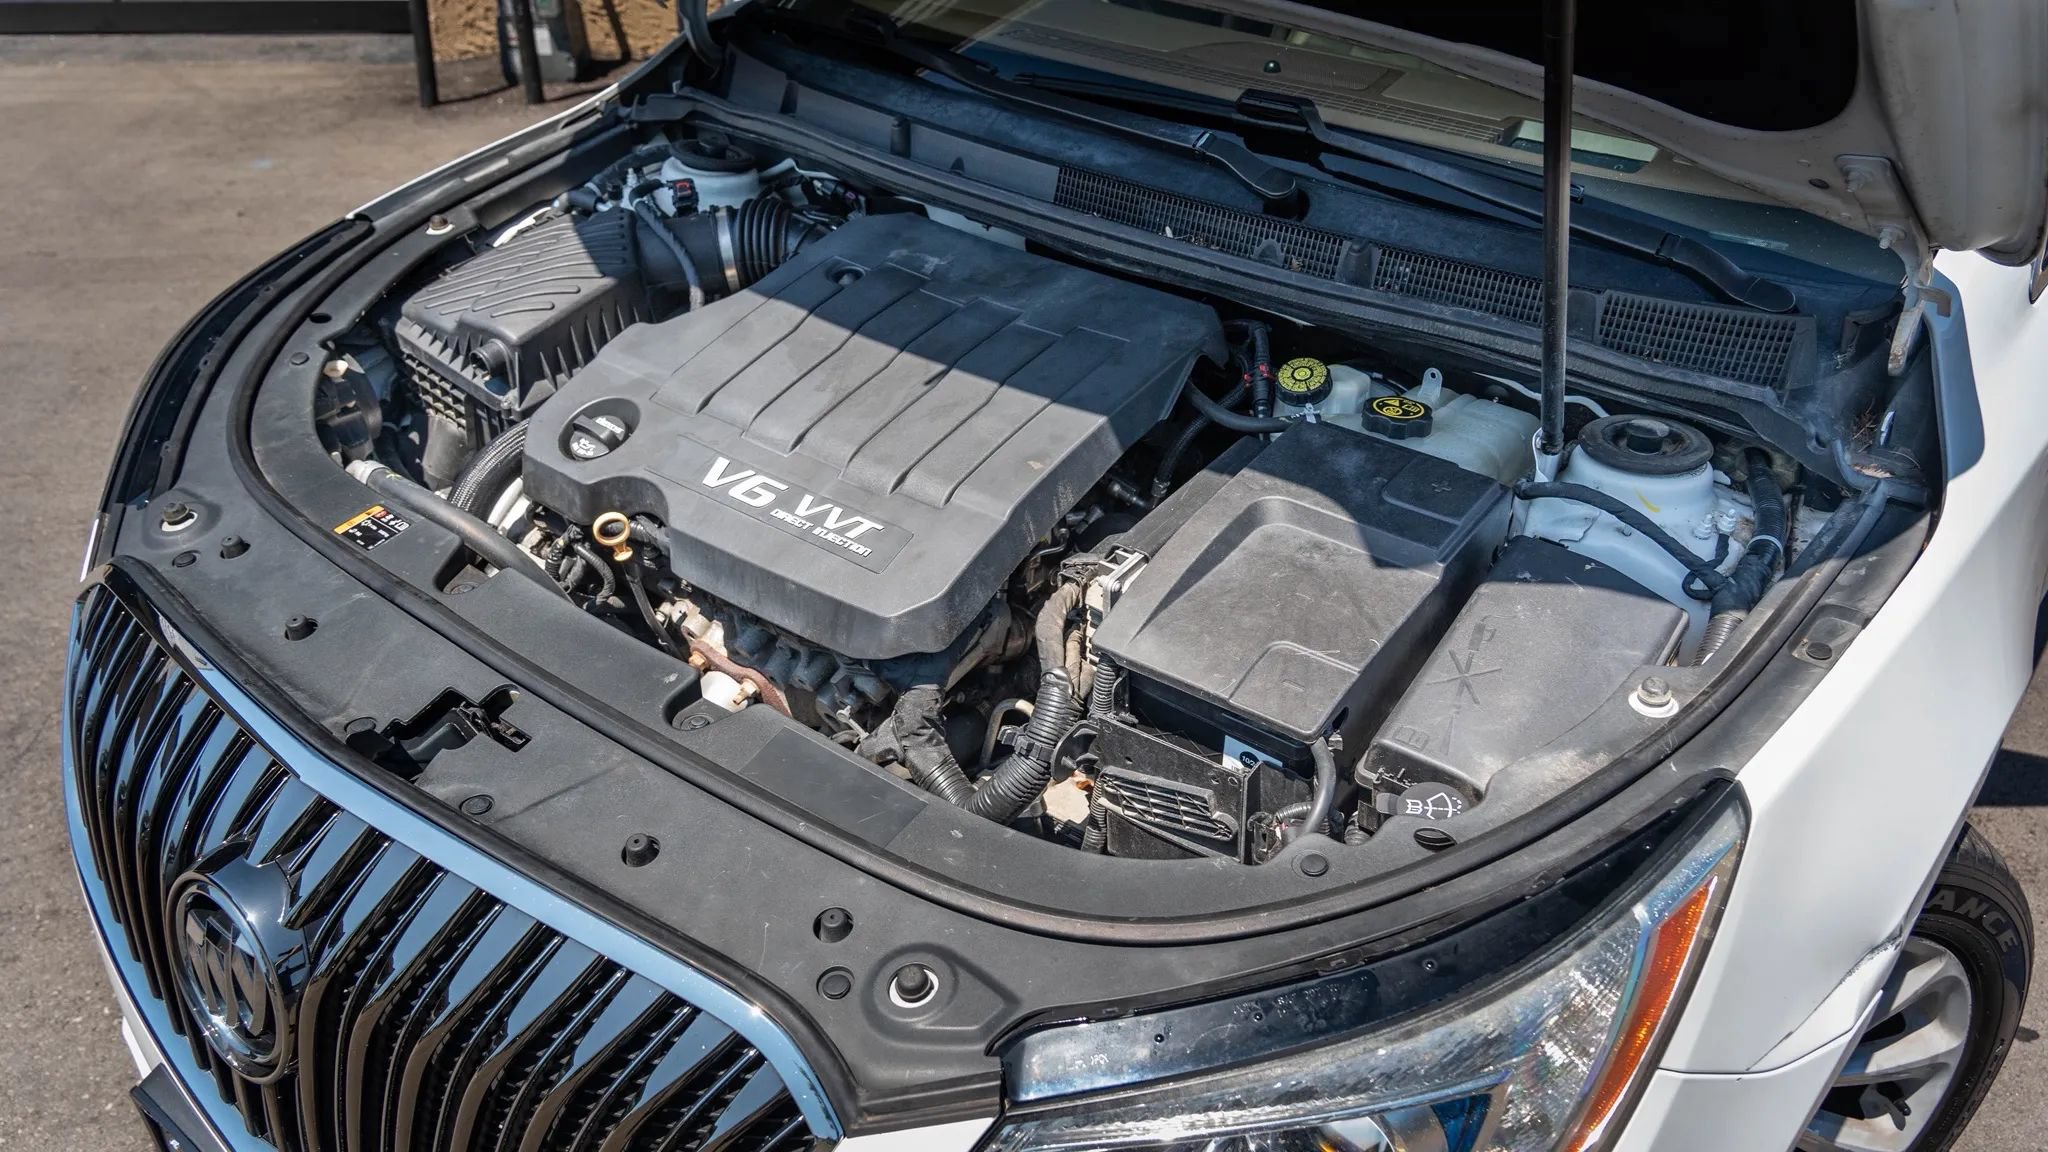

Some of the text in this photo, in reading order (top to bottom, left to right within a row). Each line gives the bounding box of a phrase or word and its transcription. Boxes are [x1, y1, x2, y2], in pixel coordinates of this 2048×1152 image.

[702, 456, 885, 540] V6 VVT
[770, 508, 872, 558] DIRECT INJECTION
